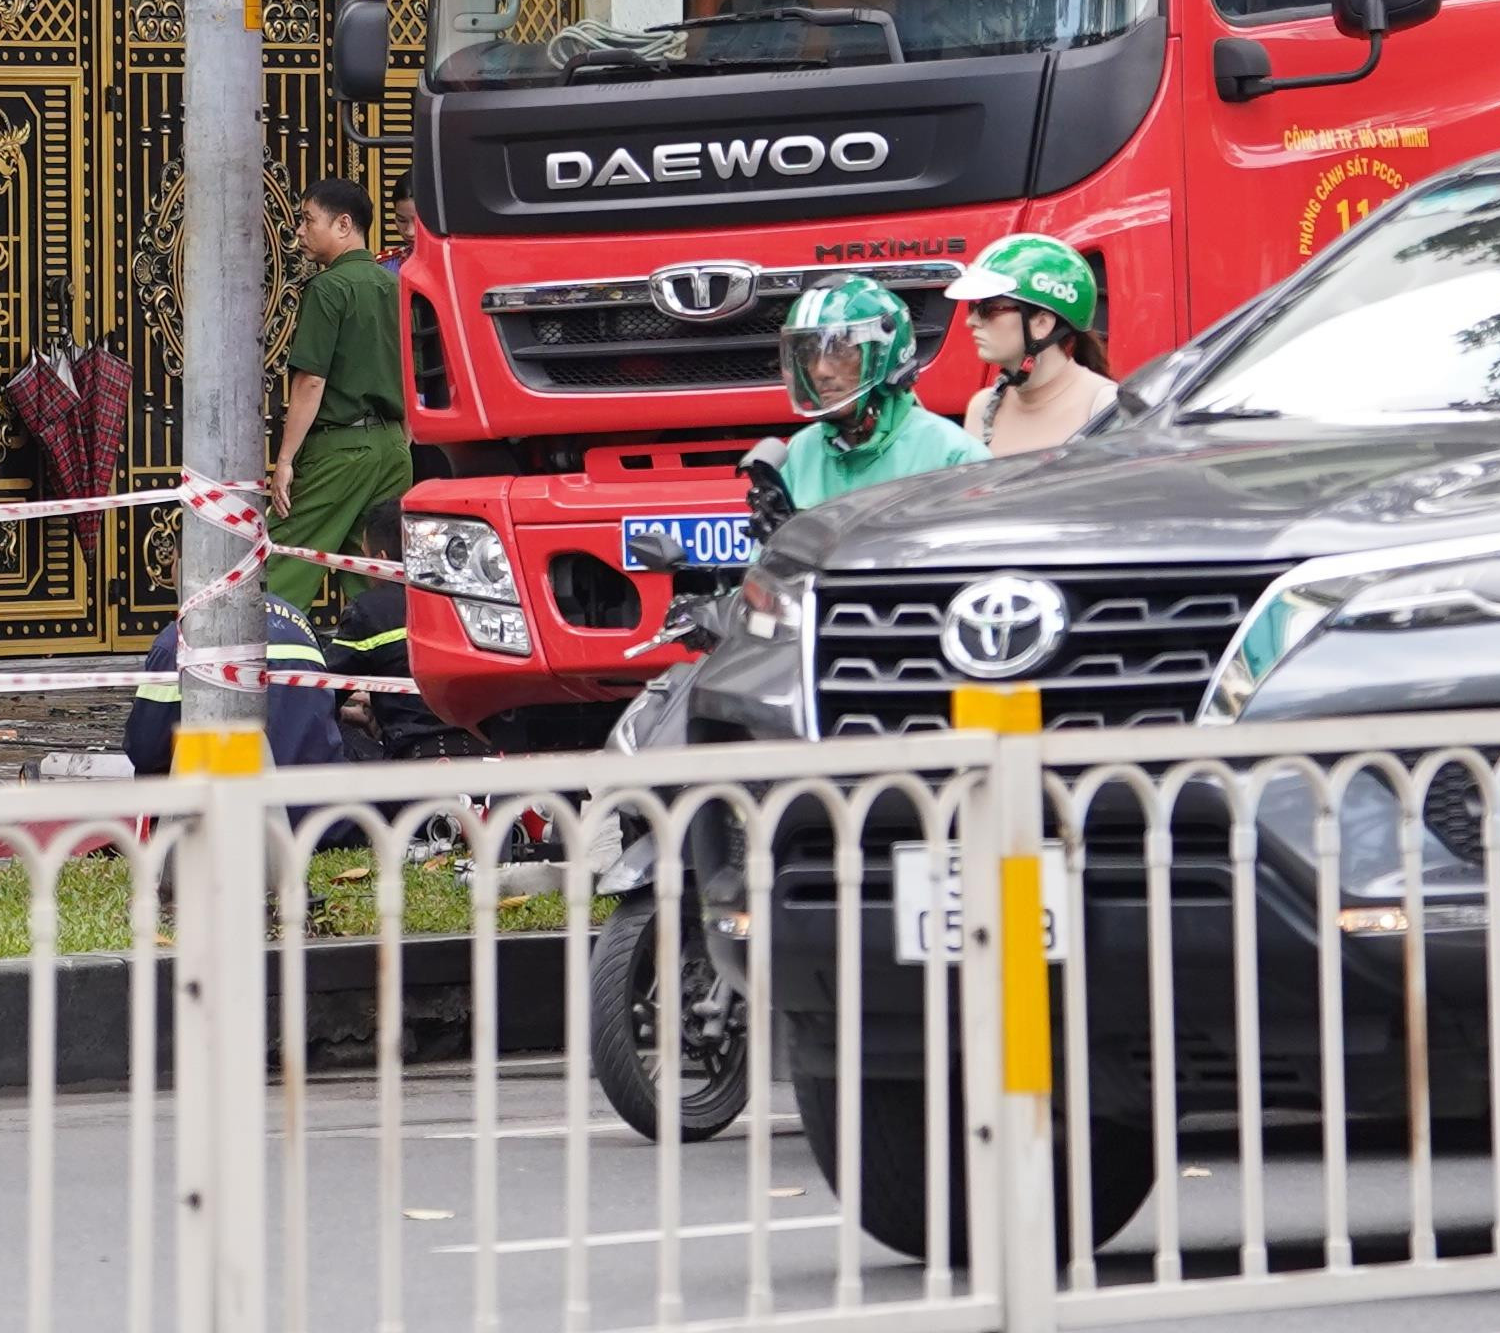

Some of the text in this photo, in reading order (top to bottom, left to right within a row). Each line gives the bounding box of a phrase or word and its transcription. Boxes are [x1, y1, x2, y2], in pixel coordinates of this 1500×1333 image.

[546, 132, 889, 190] DAEWOO
[1299, 154, 1403, 256] PHÒNG CẢNH SÁT PCCC
[815, 236, 967, 263] MAXIMUS
[1031, 271, 1079, 305] Grab
